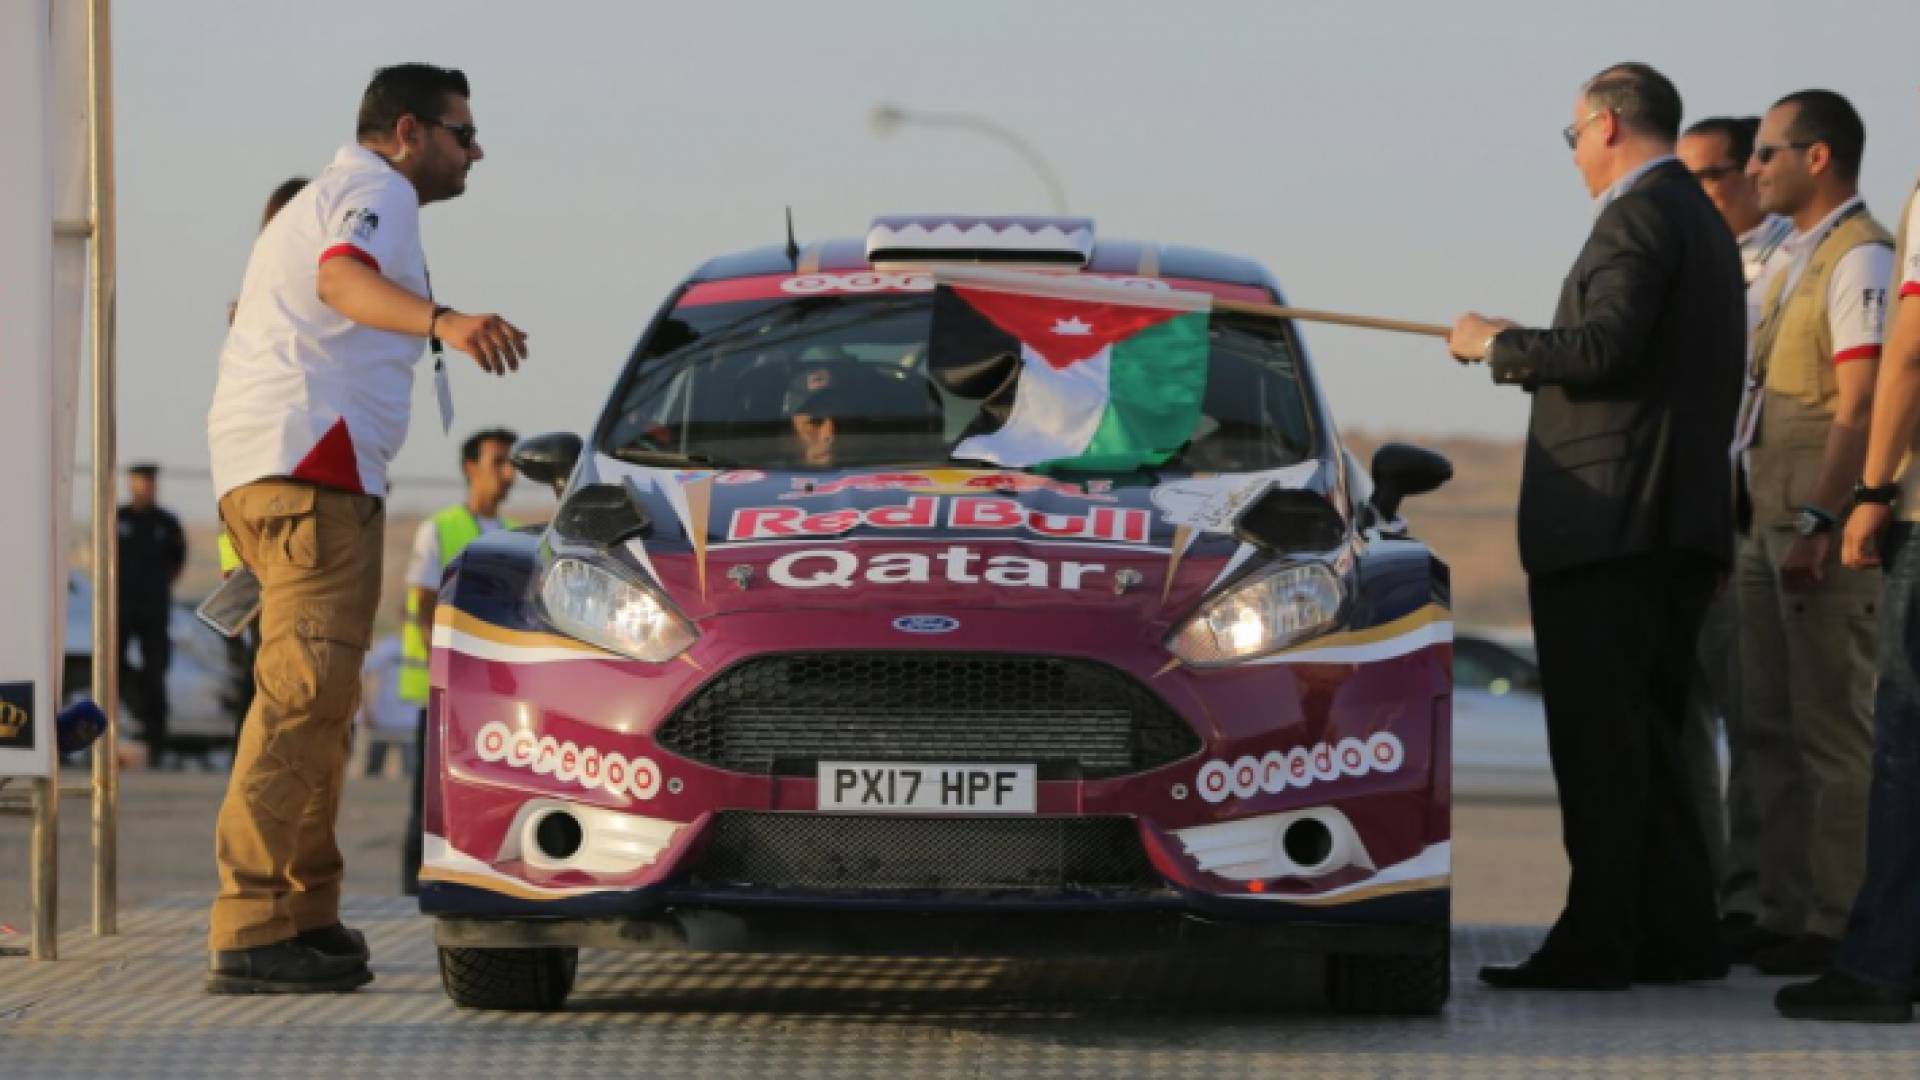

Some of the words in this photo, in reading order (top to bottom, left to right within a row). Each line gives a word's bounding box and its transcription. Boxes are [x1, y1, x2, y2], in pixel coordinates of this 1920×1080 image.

[728, 497, 939, 540] Red
[948, 497, 1150, 543] Bull
[767, 546, 1105, 589] Qatar
[835, 769, 922, 805] PX17
[941, 771, 1017, 806] HPF
[1203, 738, 1399, 796] ooredoo
